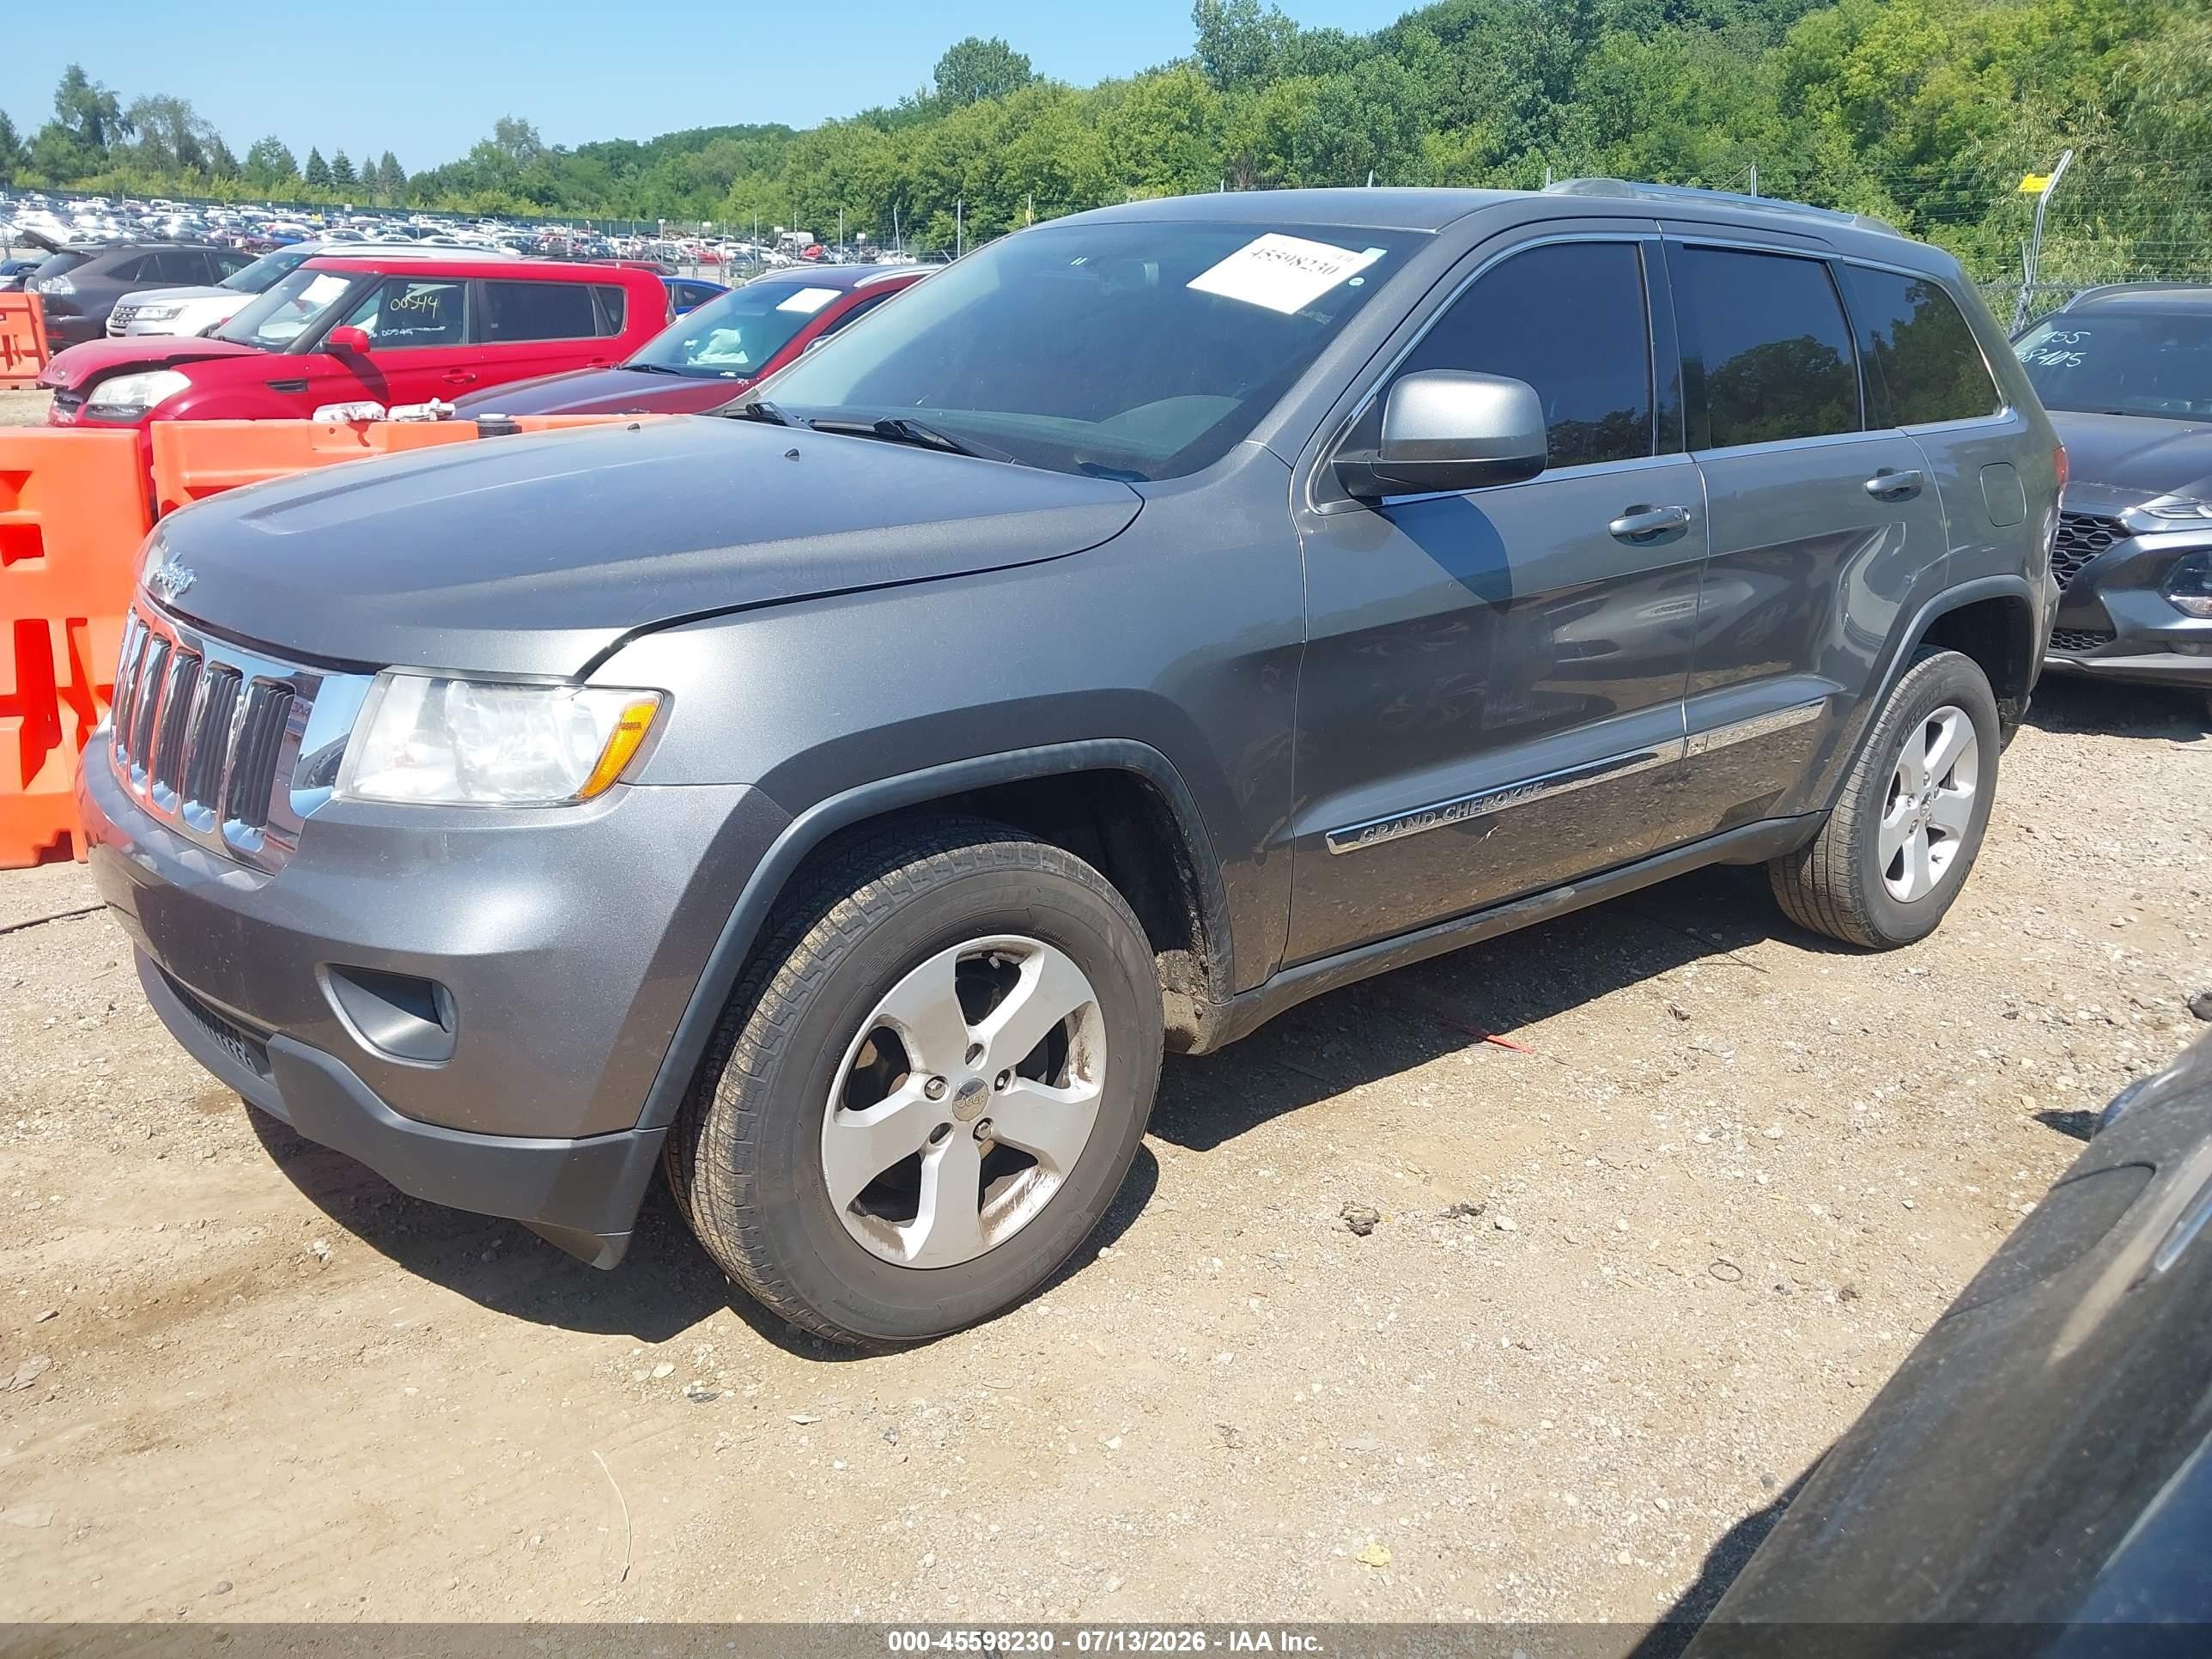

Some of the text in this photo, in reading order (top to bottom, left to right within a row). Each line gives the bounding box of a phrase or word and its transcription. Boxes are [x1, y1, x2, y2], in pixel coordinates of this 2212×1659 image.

[1360, 781, 1545, 843] GRAND CHEROKEE
[956, 1093, 985, 1109] Jeep
